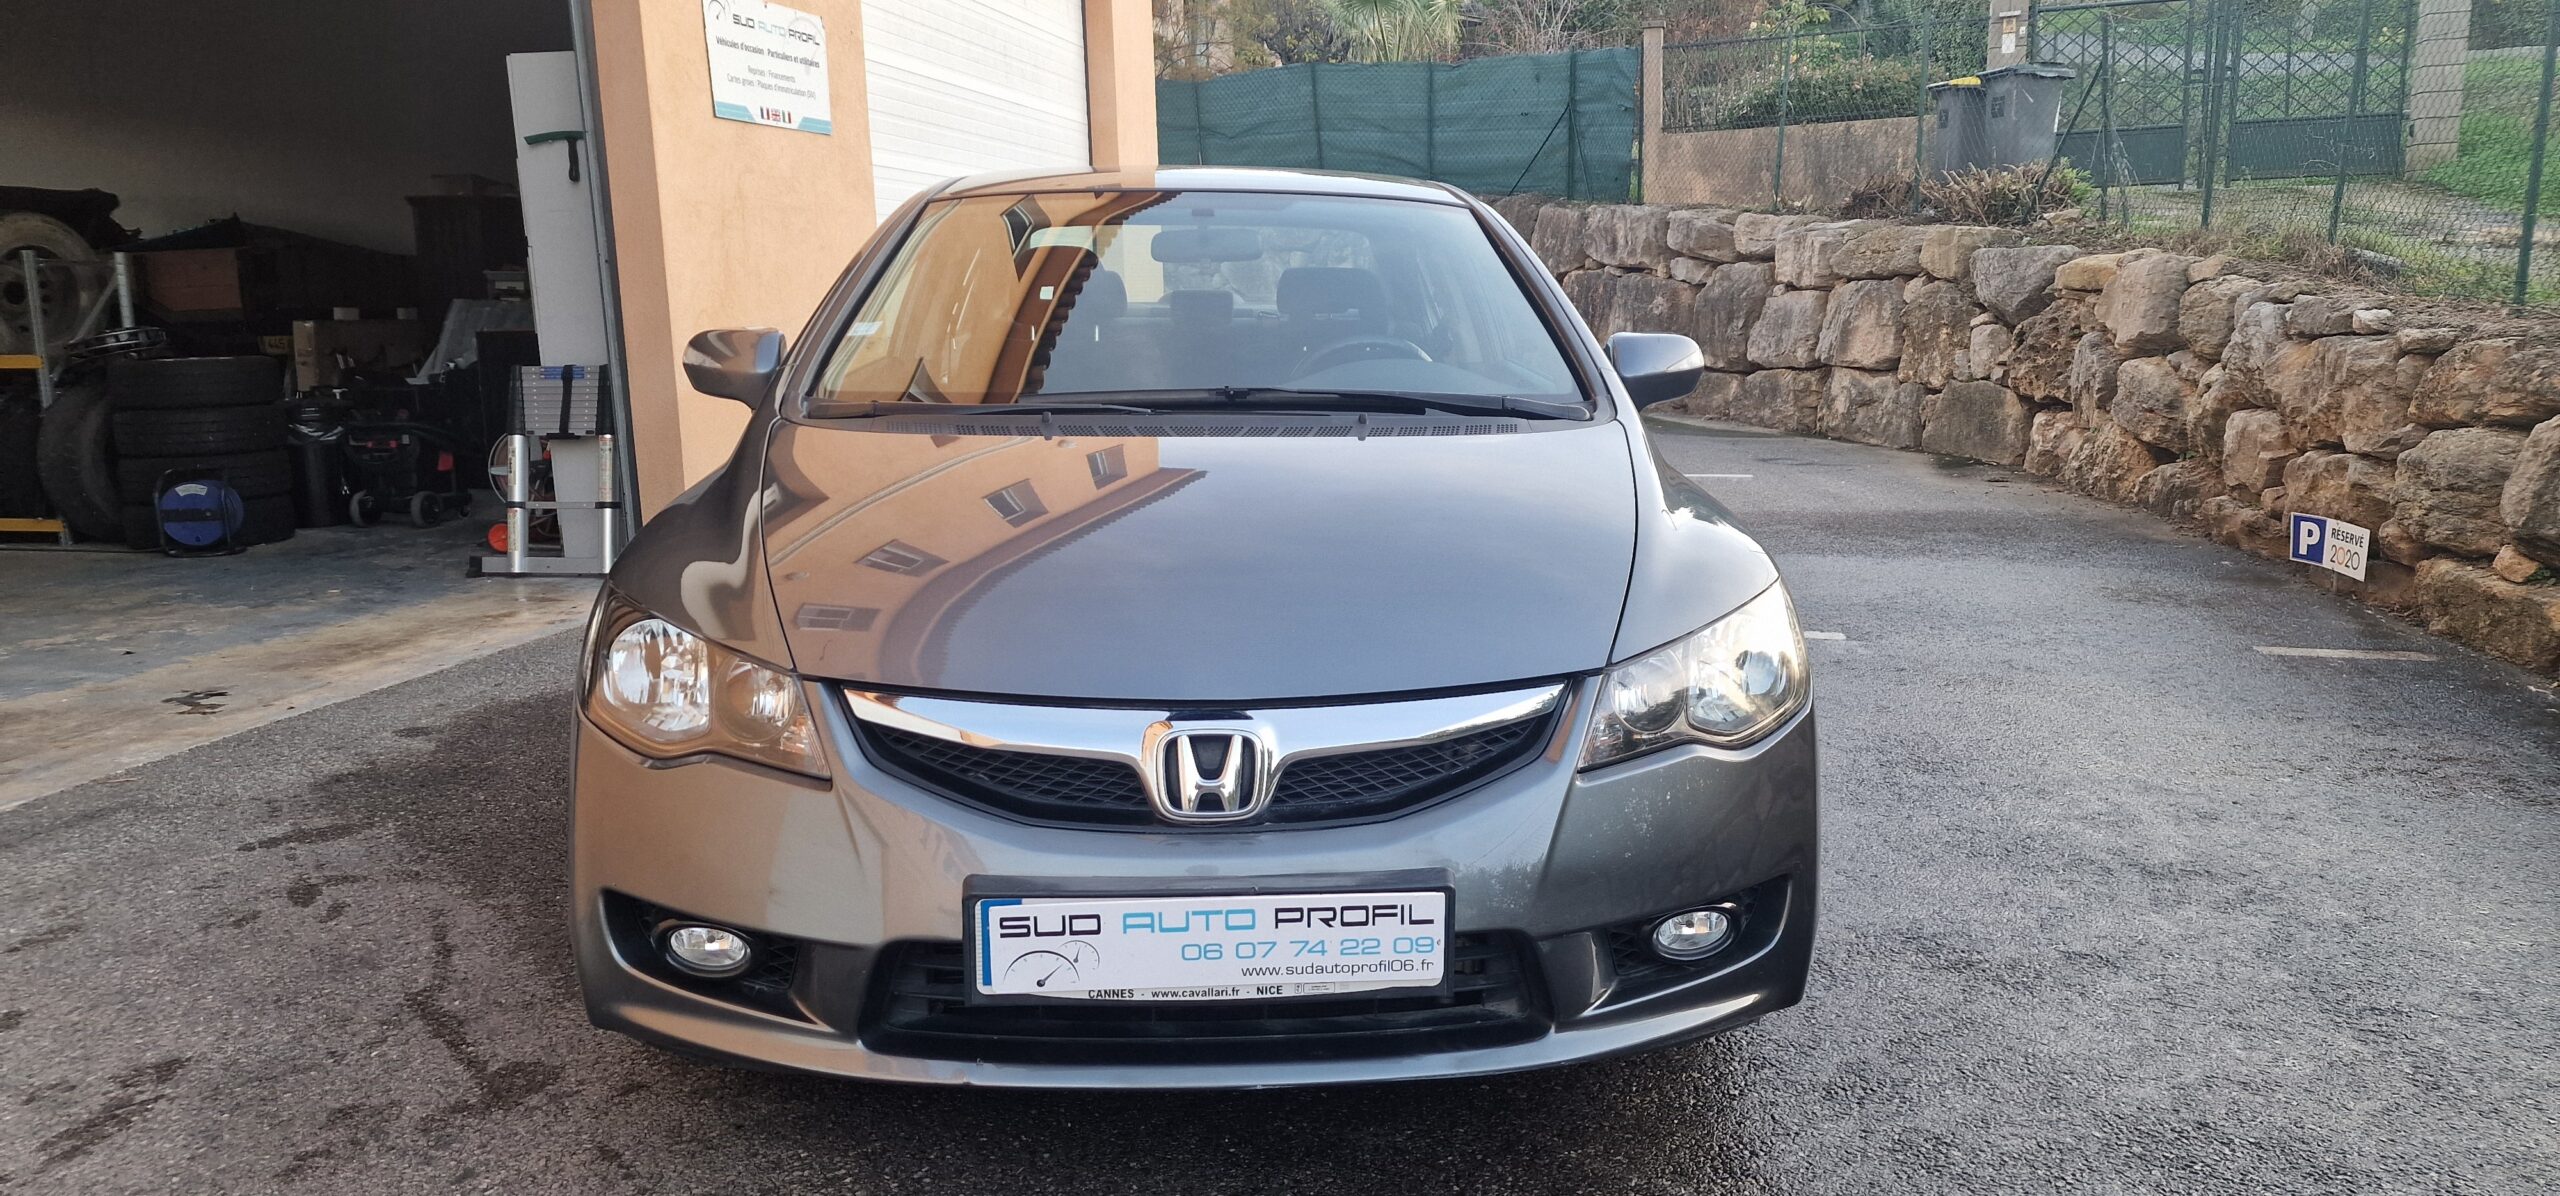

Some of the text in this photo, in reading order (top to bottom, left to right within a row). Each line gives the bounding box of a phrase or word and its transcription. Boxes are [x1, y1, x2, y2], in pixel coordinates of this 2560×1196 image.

[732, 13, 820, 46] SUD AUTO PROFIL
[716, 35, 739, 50] Véhicules
[740, 42, 764, 56] d'occasion
[767, 48, 793, 62] Particuliers
[799, 56, 820, 68] utilitaires
[2299, 521, 2320, 555] P
[2331, 527, 2364, 548] RÉSERVÉ
[2330, 544, 2360, 570] 2020
[1000, 904, 1435, 938] SUD AUTO PROFIL
[1181, 936, 1435, 961] 06 07 74 22 09
[1241, 959, 1434, 977] www.sudautoprofil06.fr
[1088, 988, 1135, 999] CANNES
[1151, 987, 1240, 998] www.cavallari.fr
[1256, 985, 1283, 995] NICE
